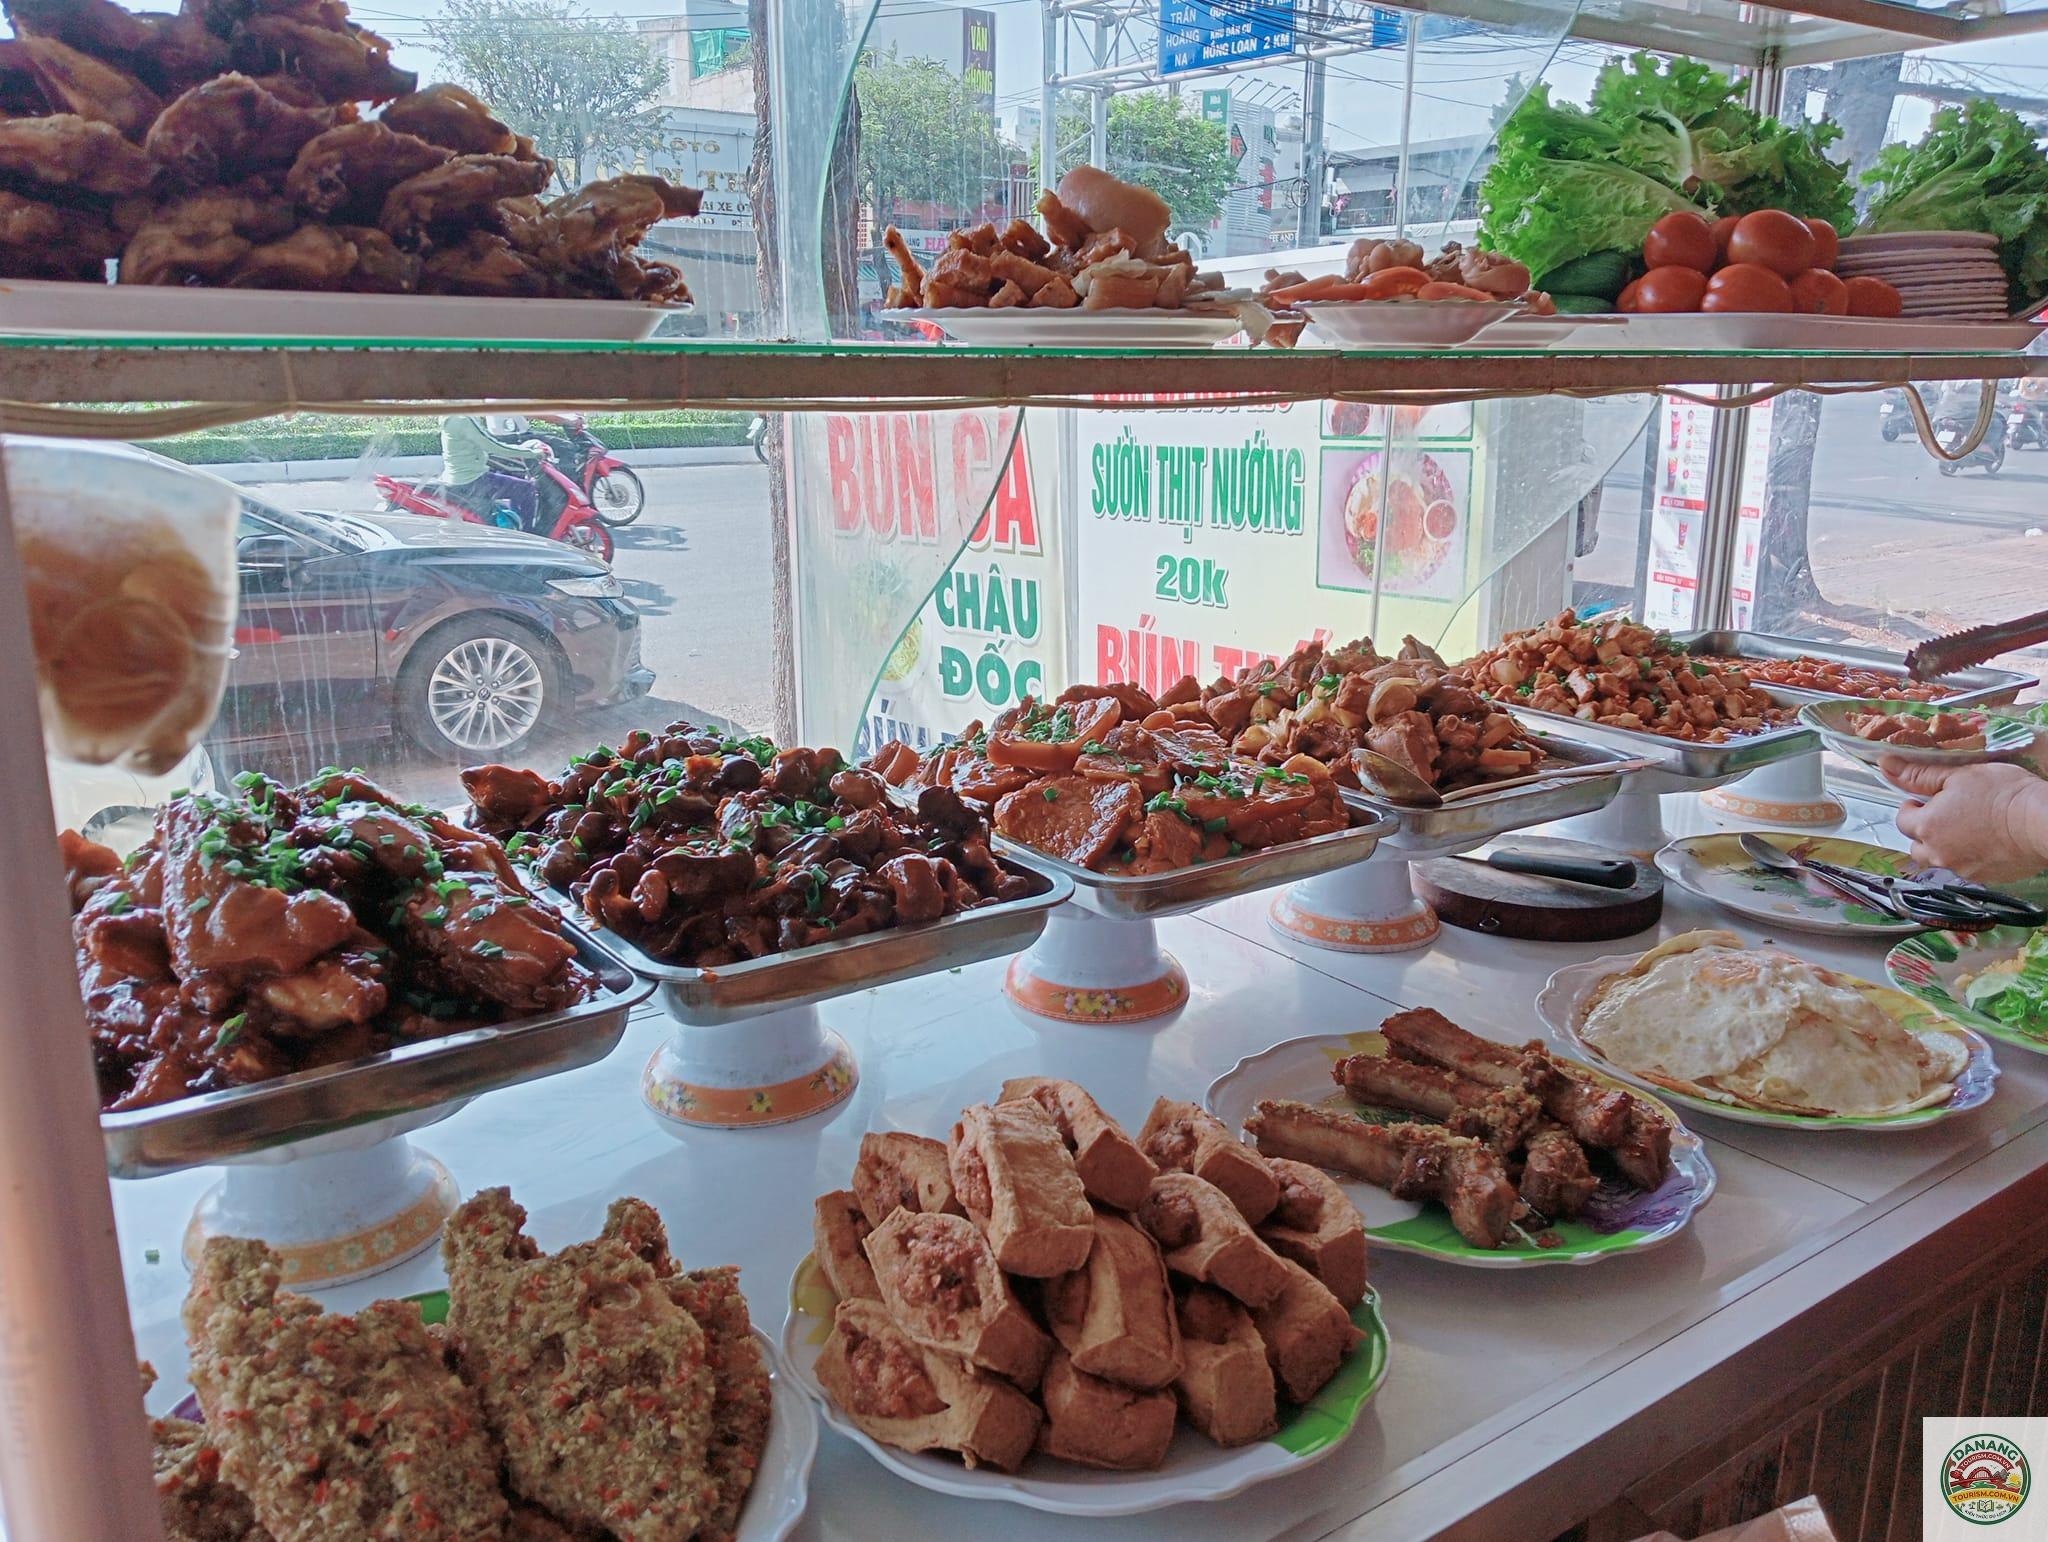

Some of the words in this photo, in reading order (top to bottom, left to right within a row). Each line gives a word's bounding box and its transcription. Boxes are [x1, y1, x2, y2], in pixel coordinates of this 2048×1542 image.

[1231, 38, 1258, 54] LOAN
[1263, 36, 1271, 49] 2
[1273, 33, 1290, 48] KM
[717, 202, 733, 211] XE
[1091, 425, 1149, 518] SƯỜN
[1156, 445, 1205, 539] THỊT
[1211, 430, 1302, 531] NƯỚNG
[935, 563, 1038, 639] CHÂU
[1155, 554, 1226, 605] 20k
[939, 639, 1043, 705] ĐỐC
